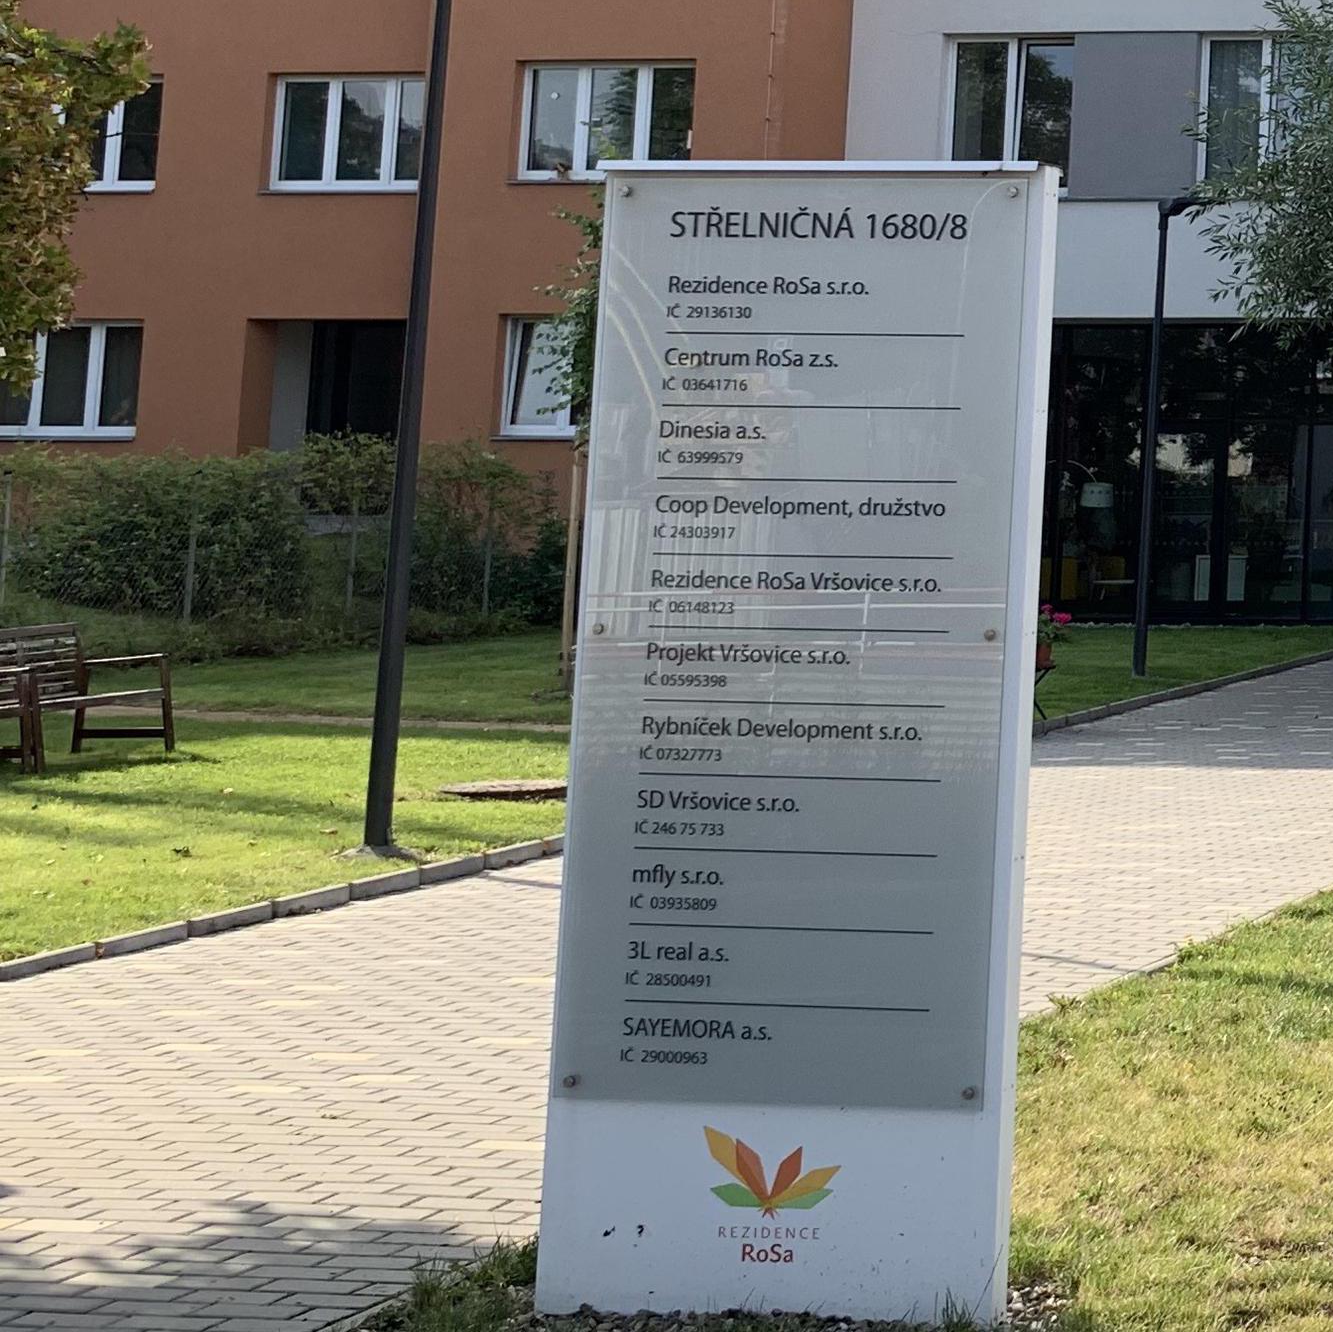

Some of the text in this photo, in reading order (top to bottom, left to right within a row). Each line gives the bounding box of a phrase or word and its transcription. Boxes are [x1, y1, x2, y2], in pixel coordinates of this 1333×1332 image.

[670, 206, 968, 242] STŘELNIČNÁ 1680/8
[668, 275, 869, 295] Rezidence RoSa s.r.o.
[666, 303, 752, 319] IČ 29136130
[664, 347, 838, 368] Centrum RoSa z.s.
[662, 375, 748, 392] IČ 03641716
[659, 420, 766, 440] Dinesia a.s.
[658, 448, 743, 464] IČ 63999579
[655, 494, 946, 519] Coop Development, družstvo
[653, 523, 736, 539] IČ 24303917
[651, 569, 942, 593] Rezidence RoSa Vršovice s.r.o.
[648, 598, 735, 614] IČ 06148123
[646, 642, 851, 666] Projekt Vršovice s.r.o.
[644, 672, 727, 687] IČ 05595398
[642, 715, 922, 742] Rybníček Development s.r.o.
[639, 744, 722, 762] IČ 07327773
[636, 789, 800, 812] SD Vršovice s.r.o.
[634, 819, 649, 834] IČ
[632, 863, 724, 888] mfly s.r.o.
[629, 893, 717, 911] IČ 03935809
[627, 940, 730, 962] 3L real a.s.
[625, 970, 711, 988] IČ 28500491
[622, 1016, 773, 1041] SAYEMORA a.s.
[619, 1046, 708, 1065] IČ 29000963
[718, 1226, 820, 1240] REZIDENCE
[741, 1243, 794, 1263] RoSa
